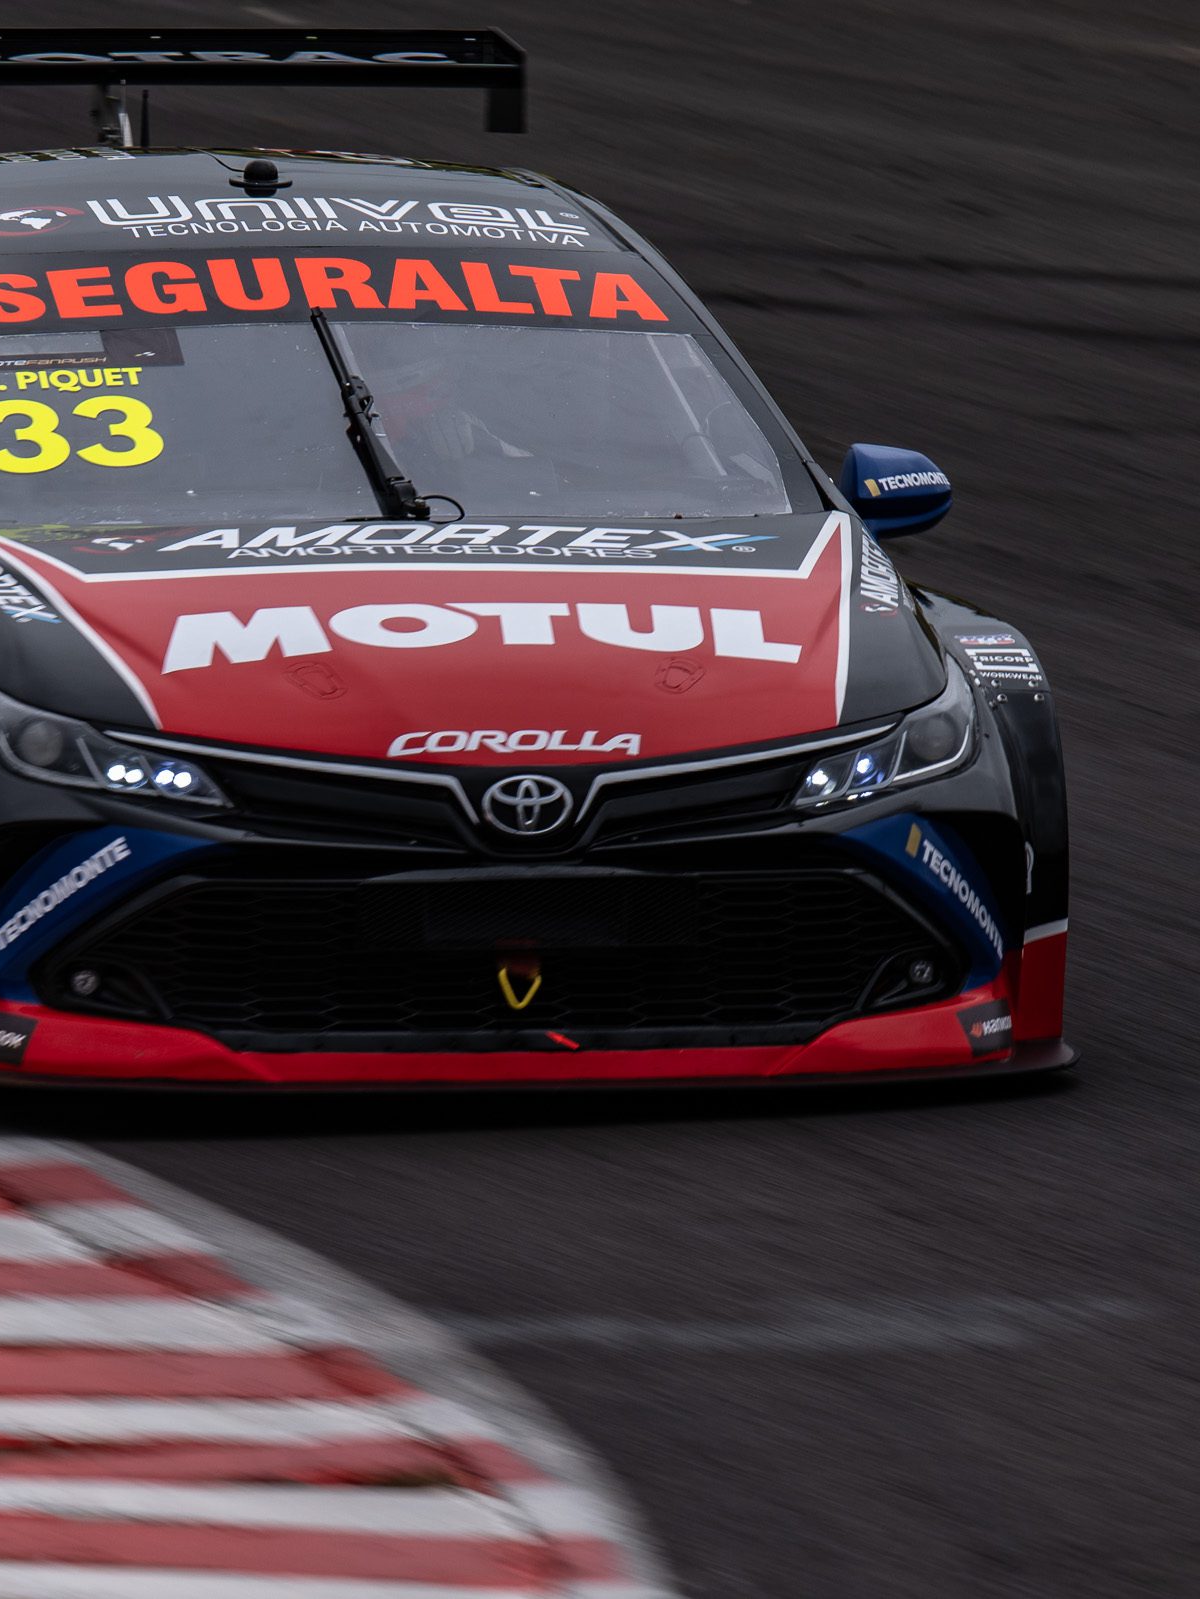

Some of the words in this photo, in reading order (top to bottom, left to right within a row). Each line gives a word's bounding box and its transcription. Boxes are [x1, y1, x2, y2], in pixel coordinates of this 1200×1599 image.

[122, 219, 349, 239] TECNOLOGIA
[358, 219, 586, 248] AUTOMOTIVA
[15, 367, 142, 393] PIQUET
[158, 523, 778, 553] AMORTEX
[226, 543, 657, 560] AMORTECEDORES
[860, 526, 899, 608] AMORTE
[161, 602, 803, 675] MOTUL
[969, 655, 1034, 663] TRICORP
[979, 671, 1043, 681] WORKWEAR
[387, 729, 642, 757] COROLLA
